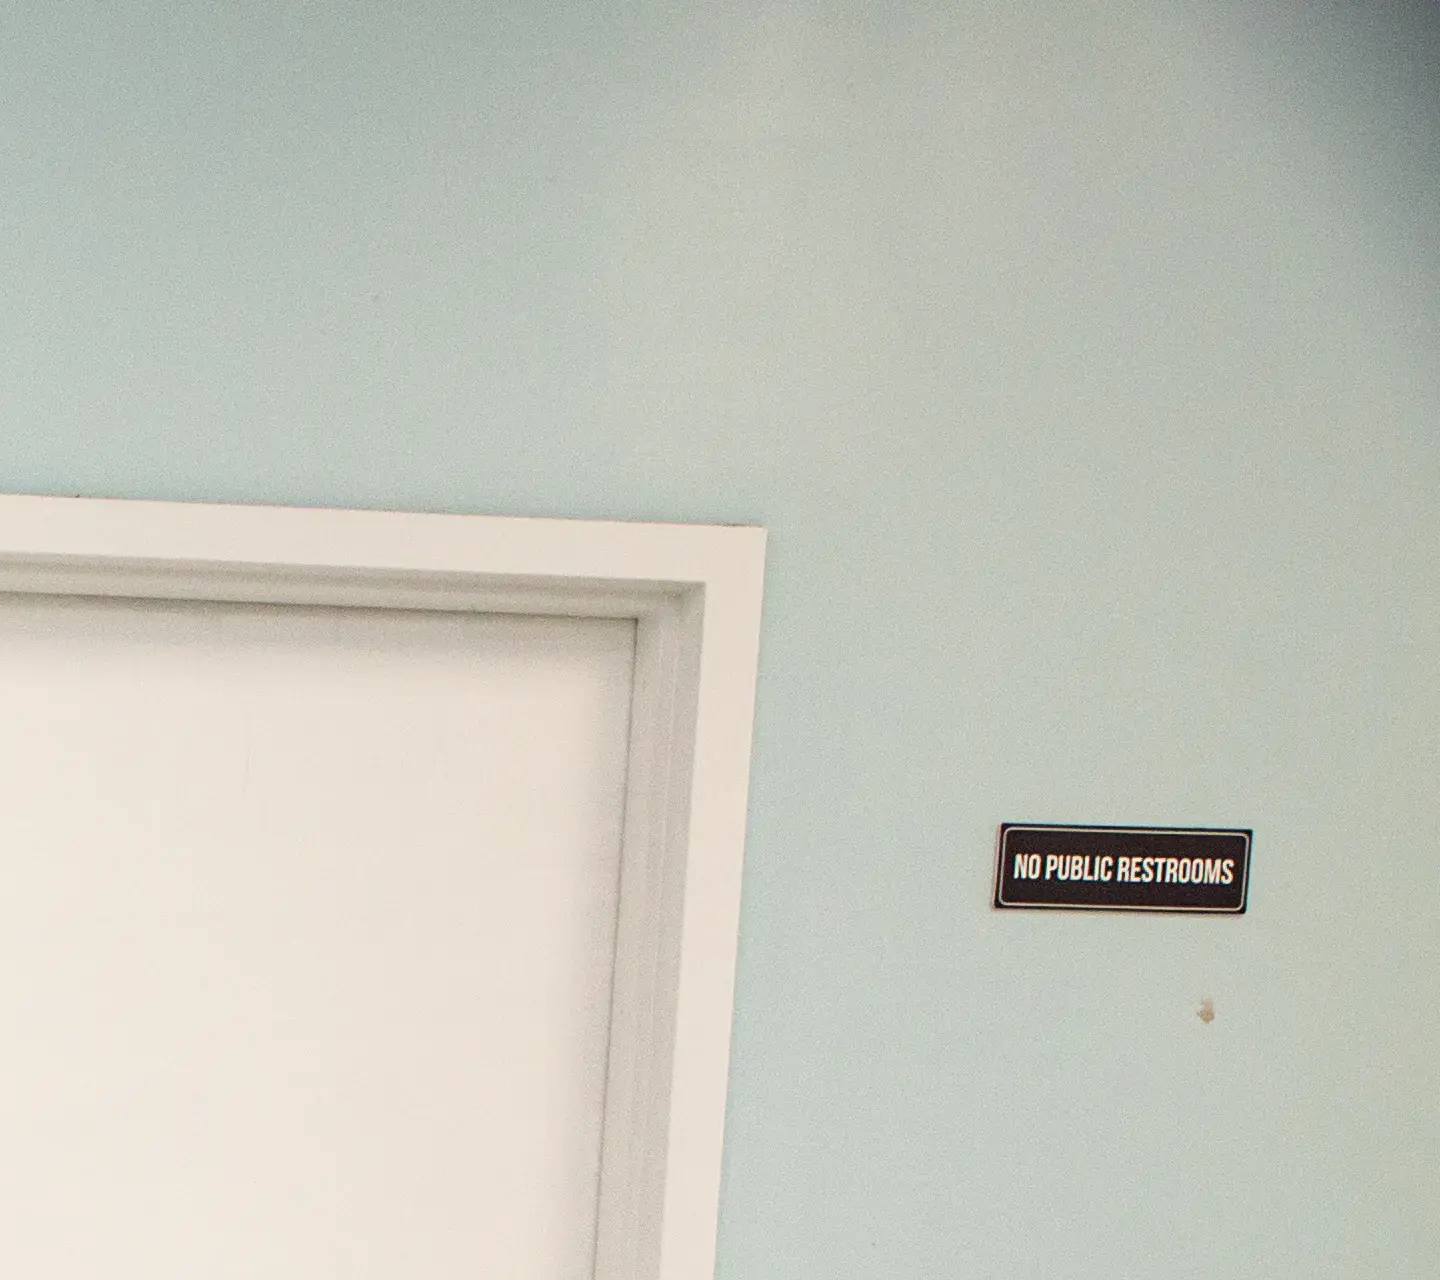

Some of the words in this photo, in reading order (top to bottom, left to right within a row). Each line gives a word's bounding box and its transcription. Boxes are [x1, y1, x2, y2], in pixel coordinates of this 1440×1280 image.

[1014, 854, 1041, 879] NO
[1045, 855, 1113, 881] PUBLIC
[1117, 857, 1234, 884] RESTROOMS
